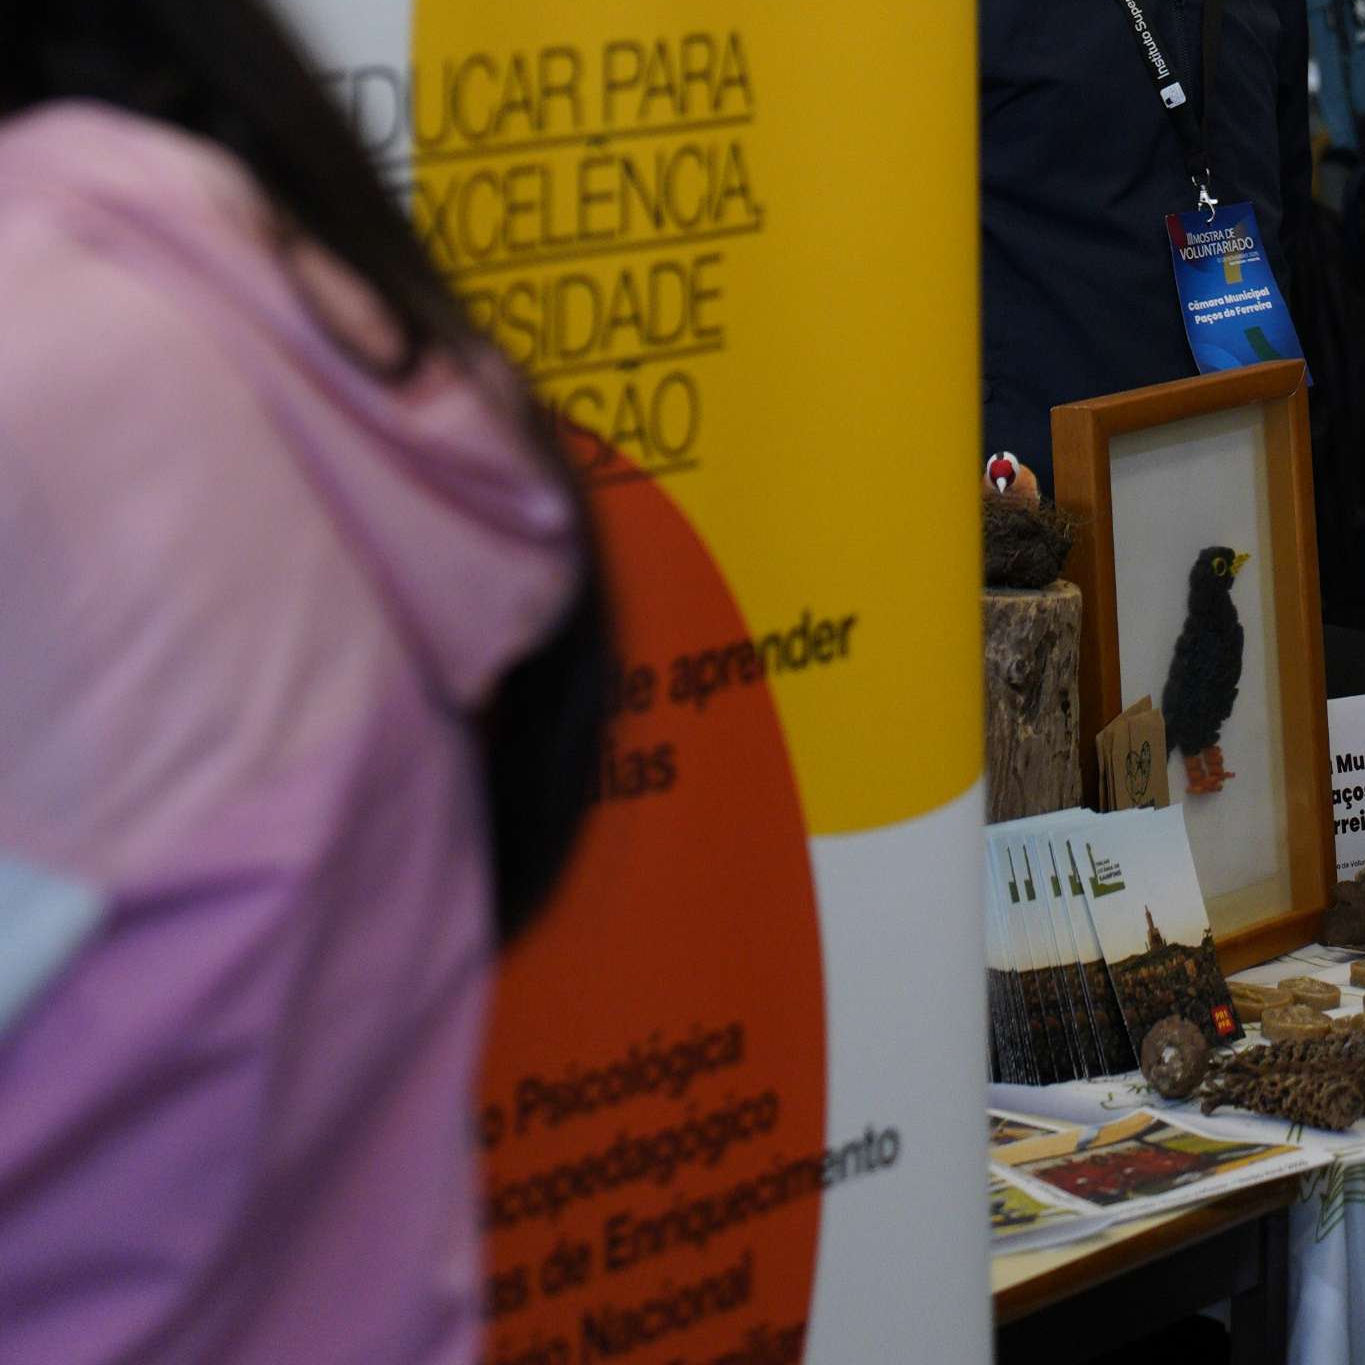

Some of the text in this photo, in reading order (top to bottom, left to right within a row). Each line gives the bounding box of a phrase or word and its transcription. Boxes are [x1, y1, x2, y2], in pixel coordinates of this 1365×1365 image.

[1142, 31, 1170, 79] Instituto
[324, 30, 755, 154] DUCAR PARA
[1180, 236, 1254, 260] VOLUNTARIADO
[1193, 230, 1225, 245] MOSTRA
[1225, 228, 1236, 238] DE
[1188, 286, 1270, 311] Câmara Municipal
[1194, 301, 1273, 325] Paços de Ferreira
[669, 609, 857, 711] aprender
[540, 1237, 592, 1297] de
[605, 1125, 900, 1272] Enriquecimento
